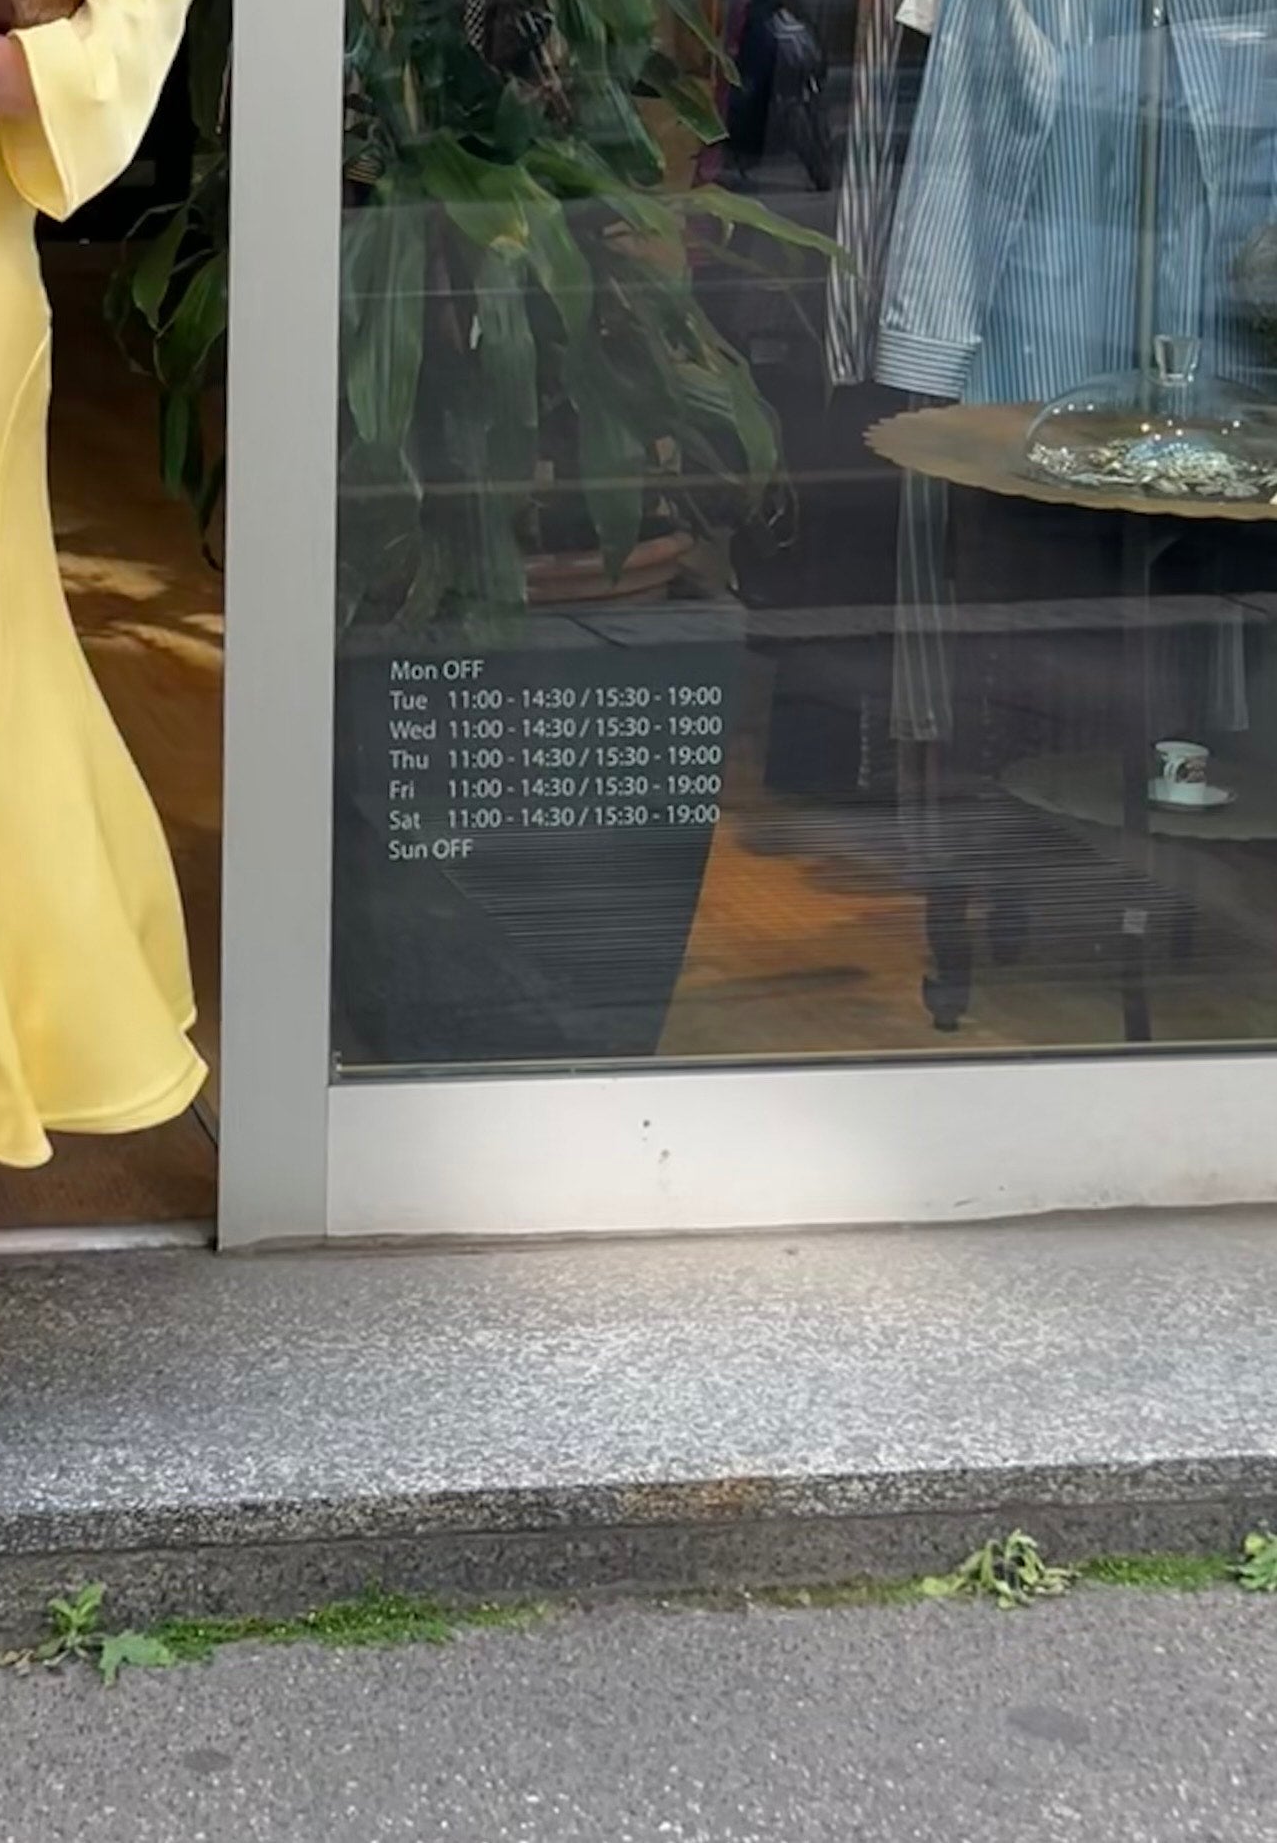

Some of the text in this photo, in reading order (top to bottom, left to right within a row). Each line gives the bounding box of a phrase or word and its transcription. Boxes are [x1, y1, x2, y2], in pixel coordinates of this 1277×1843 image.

[390, 659, 484, 681] Mon OFF
[389, 690, 428, 711] Tue
[448, 689, 503, 710] 11:00
[522, 688, 576, 708] 14:30
[578, 688, 591, 708] /
[595, 687, 650, 708] 15:30
[668, 686, 722, 706] 19:00
[389, 719, 437, 740] Wed
[449, 719, 504, 740] 11:00
[523, 718, 577, 738] 14:30
[579, 718, 592, 738] /
[596, 717, 651, 738] 15:30
[669, 716, 723, 736] 19:00
[389, 749, 429, 770] Thu
[448, 748, 503, 769] 11:00
[522, 747, 576, 767] 14:30
[578, 747, 591, 767] /
[595, 746, 650, 767] 15:30
[668, 745, 722, 765] 19:00
[389, 779, 415, 800] Fri
[448, 778, 503, 799] 11:00
[522, 777, 576, 797] 14:30
[578, 777, 591, 797] /
[595, 776, 650, 797] 15:30
[668, 775, 722, 795] 19:00
[389, 809, 421, 831] Sat
[447, 808, 502, 829] 11:00
[521, 807, 575, 827] 14:30
[577, 807, 590, 827] /
[594, 806, 649, 827] 15:30
[667, 805, 721, 825] 19:00
[388, 838, 474, 860] Sun OFF
